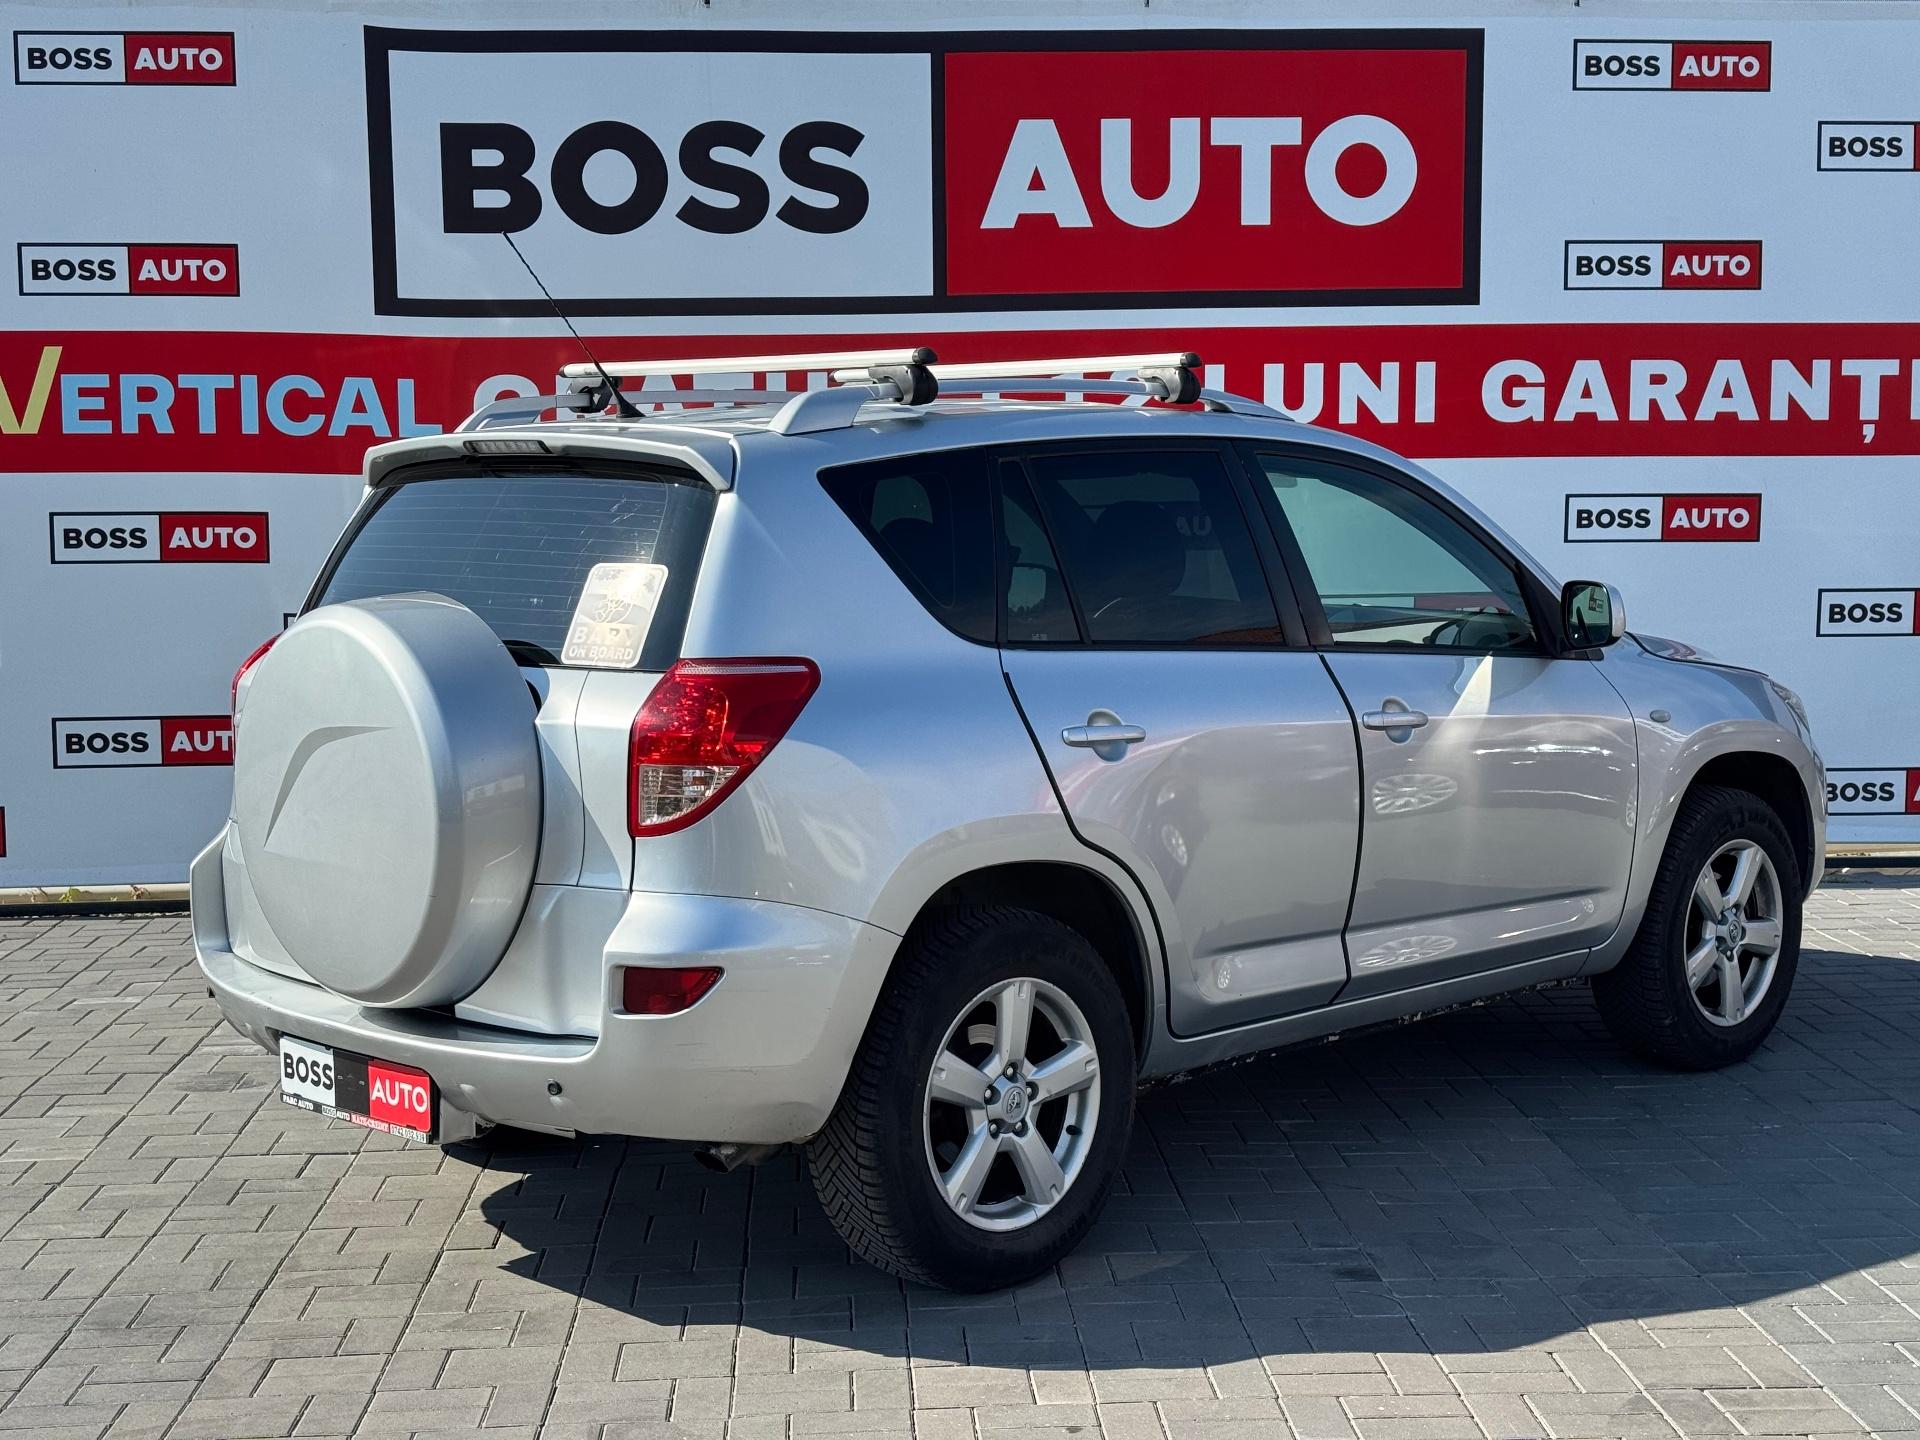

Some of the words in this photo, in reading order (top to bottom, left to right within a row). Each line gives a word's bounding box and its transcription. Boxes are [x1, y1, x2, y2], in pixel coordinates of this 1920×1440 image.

[27, 48, 112, 70] BOSS
[134, 48, 222, 70] AUTO
[1584, 55, 1660, 77] BOSS
[1680, 55, 1760, 78] AUTO
[1828, 136, 1903, 158] BOSS
[440, 120, 869, 235] BOSS
[980, 114, 1418, 231] AUTO
[31, 258, 117, 281] BOSS
[138, 259, 227, 282] AUTO
[1575, 255, 1652, 277] BOSS
[1670, 255, 1751, 277] AUTO
[0, 346, 442, 438] VERTICAL
[1576, 508, 1651, 530] BOSS
[1669, 507, 1750, 529] AUTO
[63, 527, 148, 549] BOSS
[168, 526, 257, 549] AUTO
[1828, 603, 1903, 624] BOSS
[65, 731, 149, 753] BOSS
[1827, 782, 1895, 802] BOSS
[283, 1052, 334, 1091] BOSS
[371, 1075, 428, 1113] AUTO
[297, 1100, 314, 1111] AUTO
